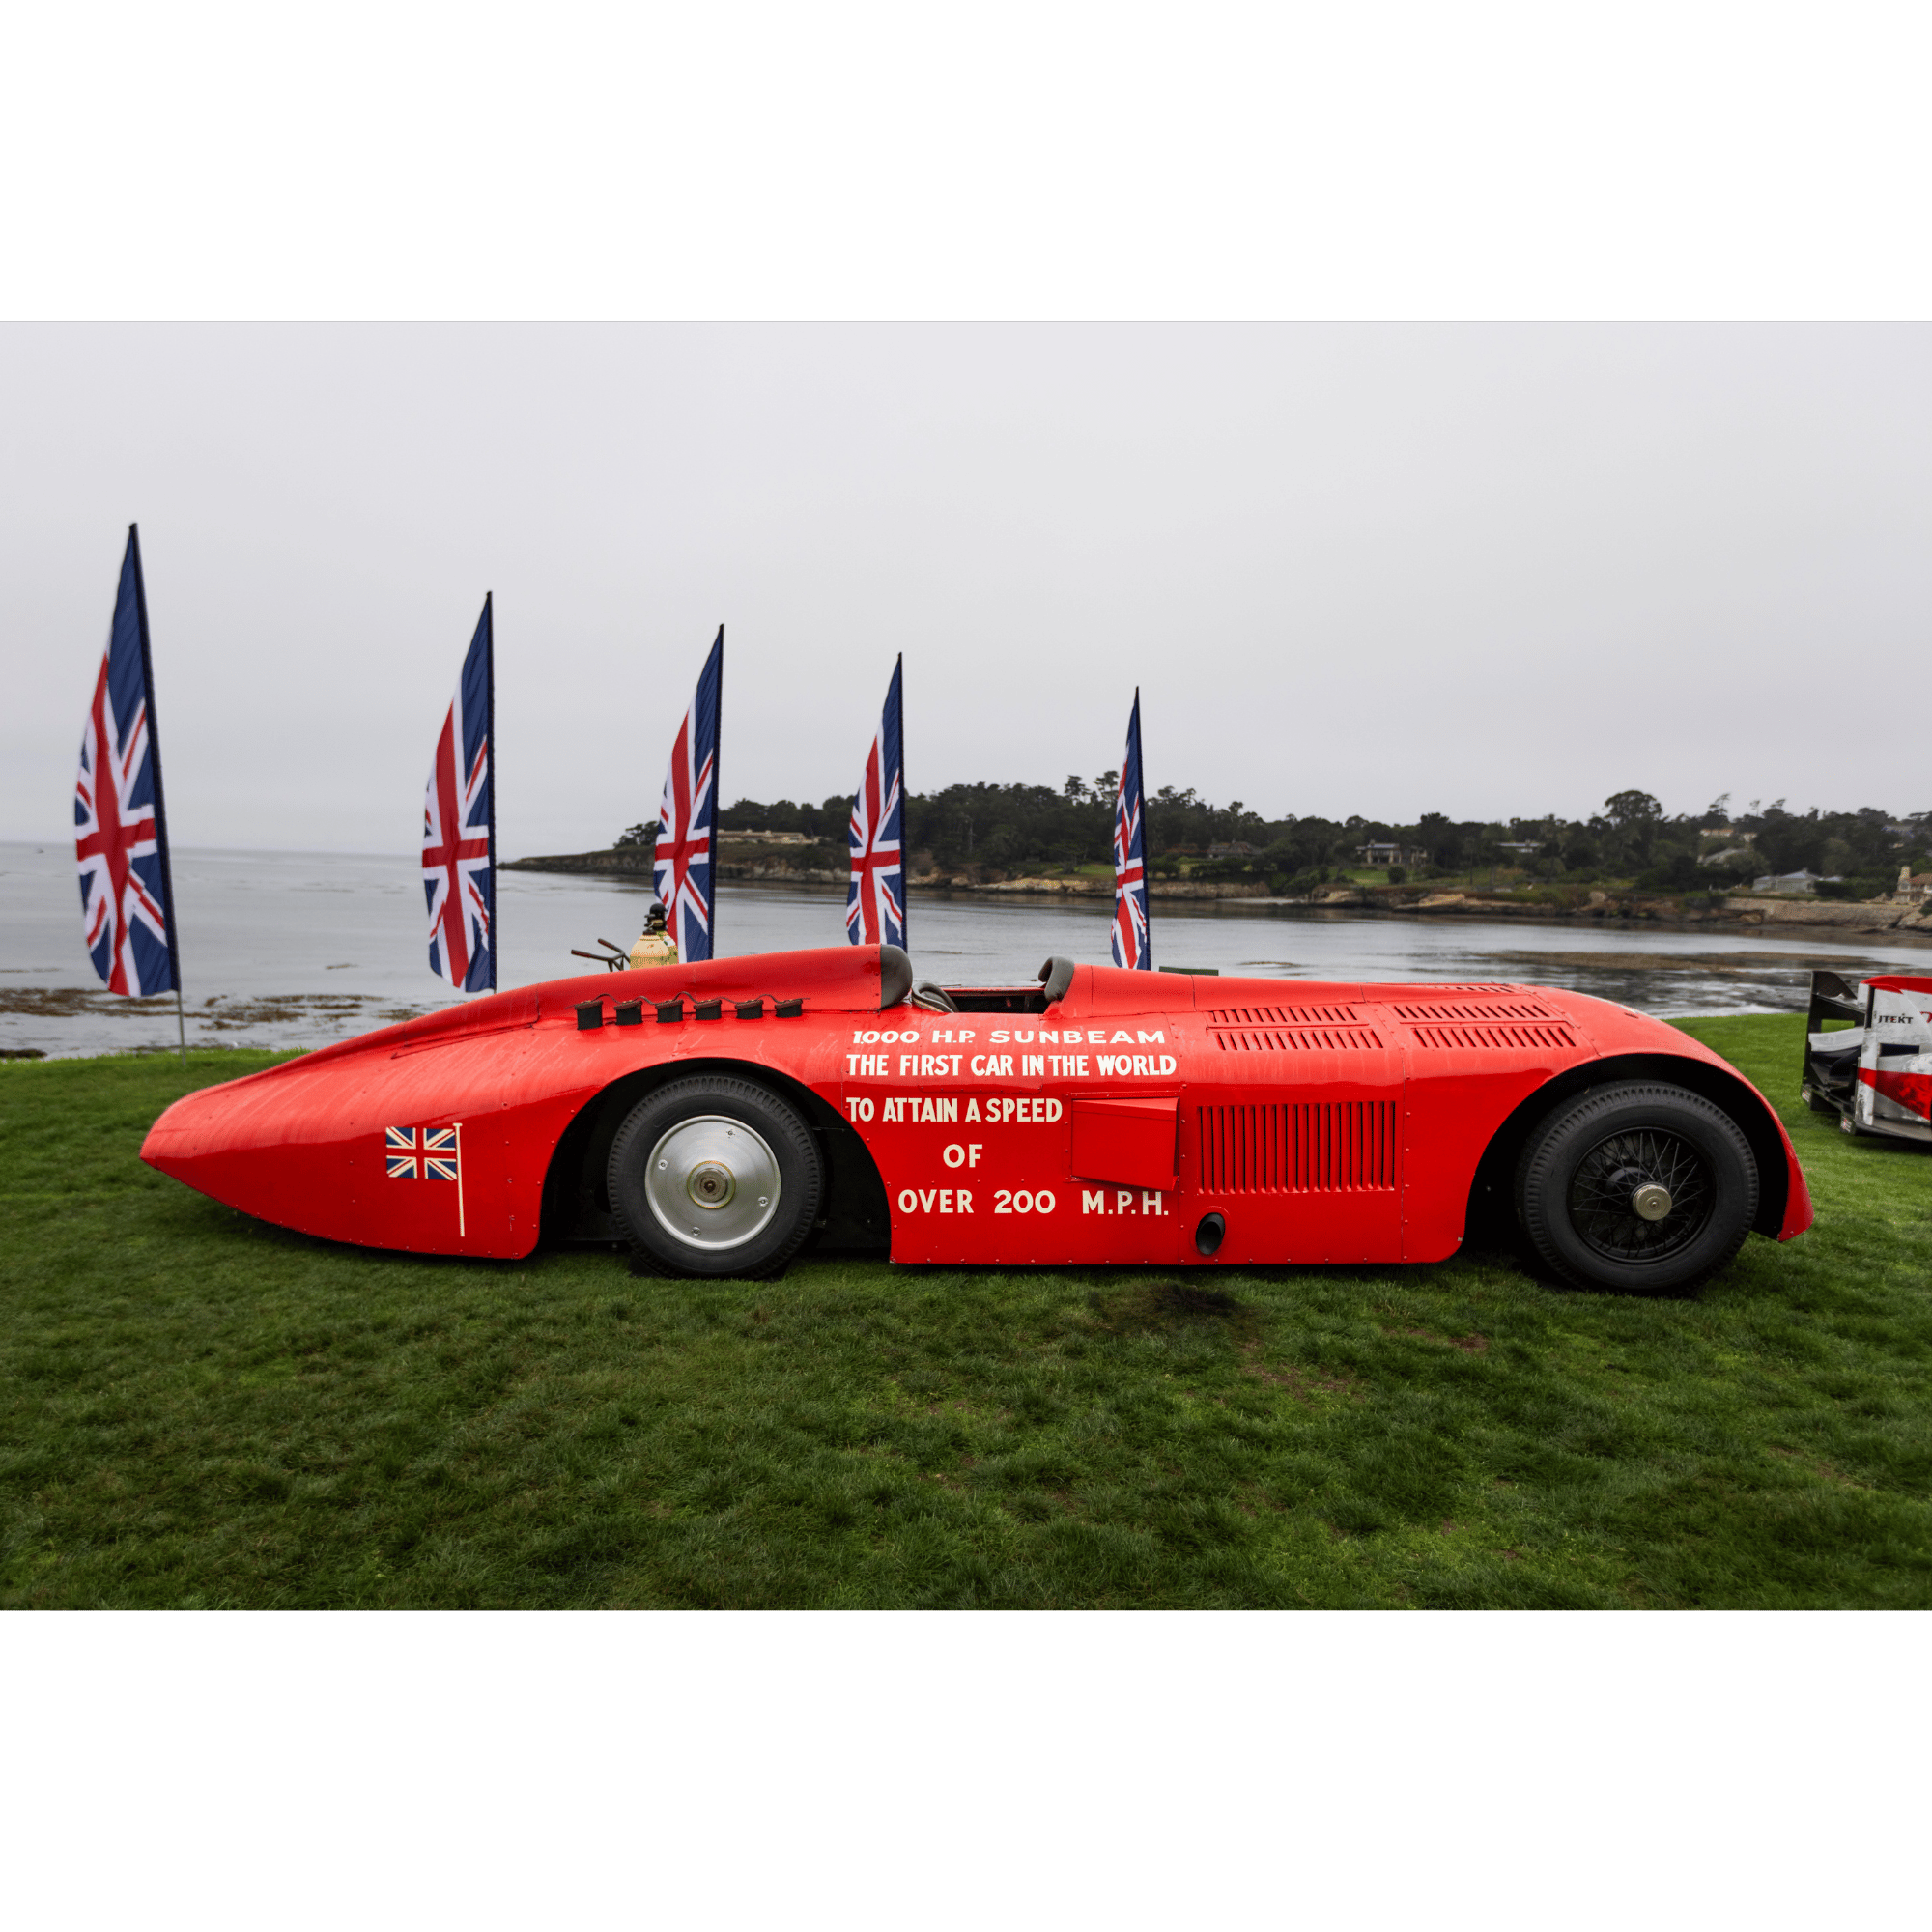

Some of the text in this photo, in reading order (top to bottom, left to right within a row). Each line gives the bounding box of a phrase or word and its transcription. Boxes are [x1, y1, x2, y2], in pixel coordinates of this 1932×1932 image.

[1878, 1015, 1914, 1024] JTEKT
[989, 1030, 1165, 1044] SUNBEAM
[846, 1054, 1177, 1077] THE FIRST CAR IN THE WORLD
[846, 1097, 1063, 1122] TO ATTAIN A SPEED
[943, 1144, 983, 1168] OF
[898, 1189, 1170, 1215] OVER 200 M.P.H.
